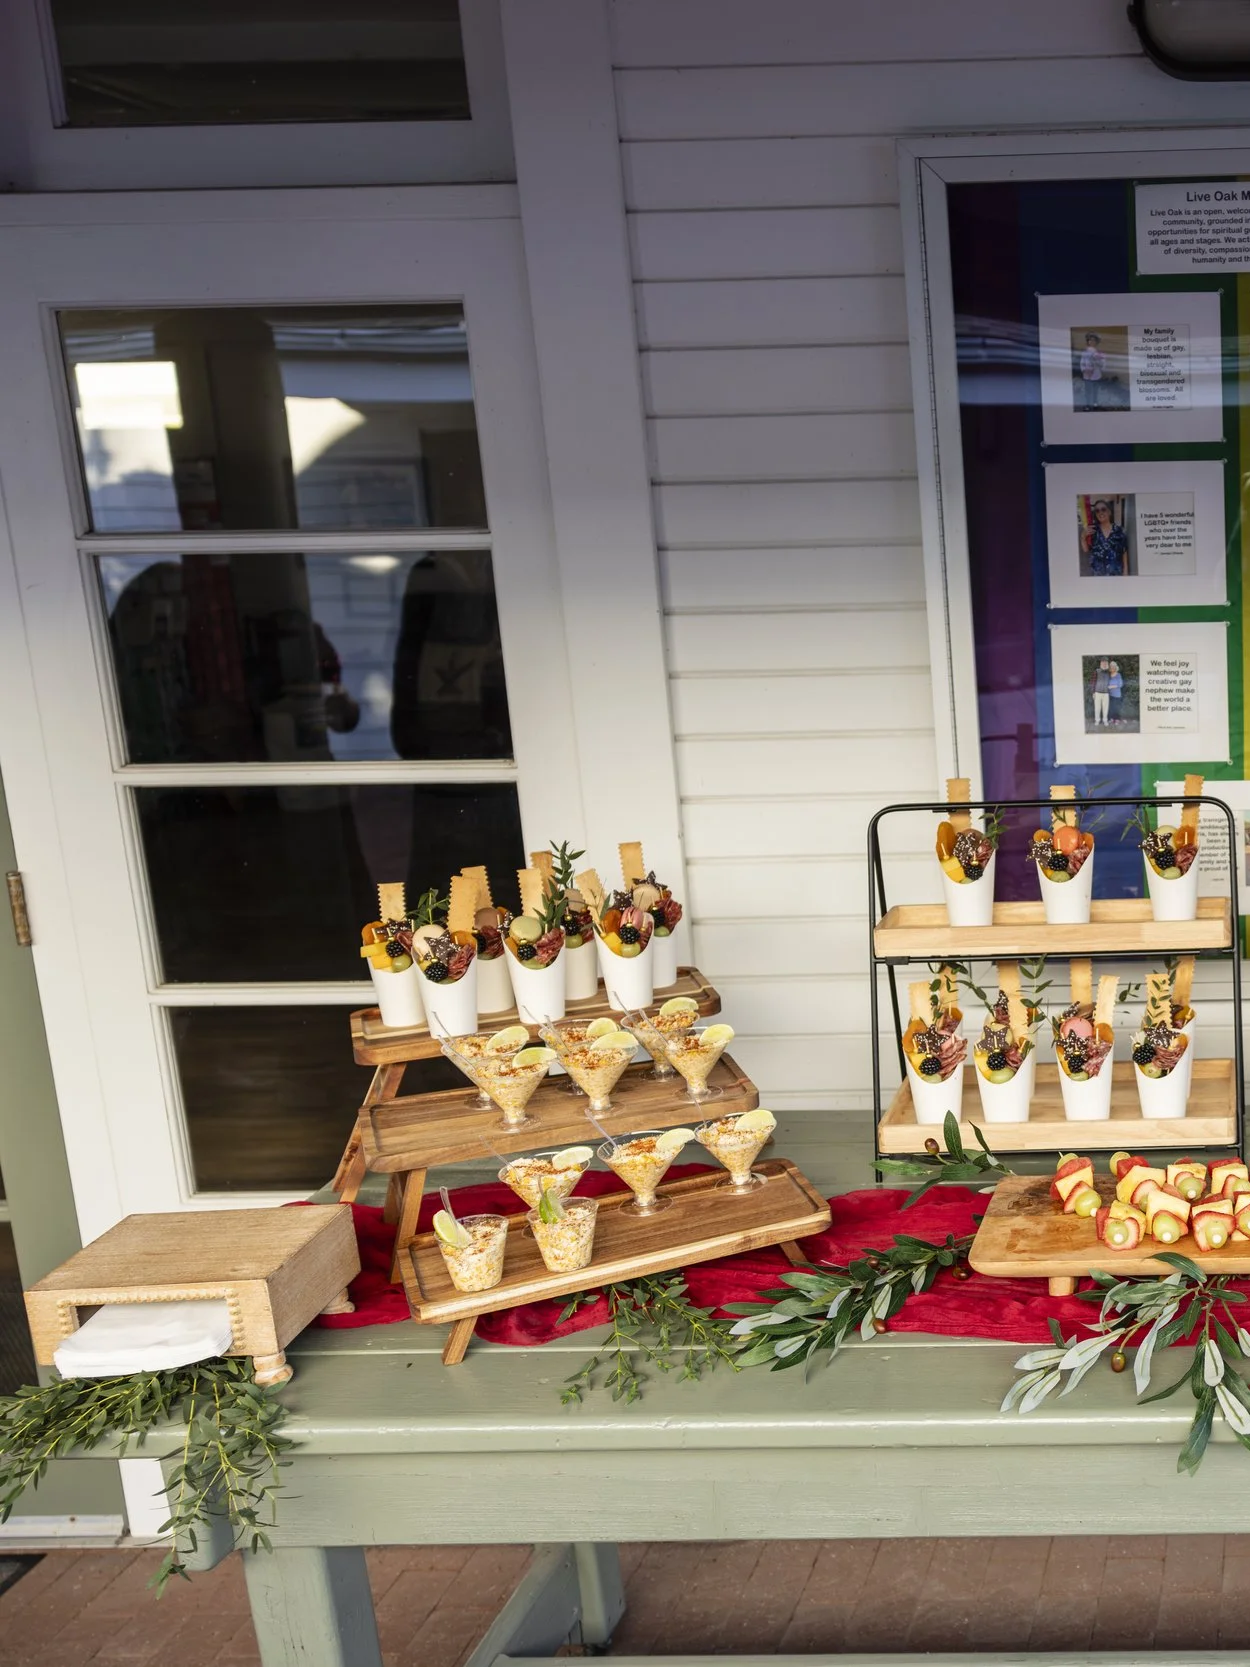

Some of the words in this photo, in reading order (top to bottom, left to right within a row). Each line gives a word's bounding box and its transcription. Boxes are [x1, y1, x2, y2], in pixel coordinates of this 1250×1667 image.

[1186, 192, 1211, 202] Live
[1214, 191, 1238, 201] Oak
[1207, 217, 1243, 225] grounded
[1147, 228, 1198, 236] opportunities
[1212, 227, 1242, 235] spiritual
[1174, 247, 1207, 255] diversity,
[1192, 256, 1226, 264] humanity
[1155, 327, 1175, 335] family
[1178, 660, 1190, 668] joy
